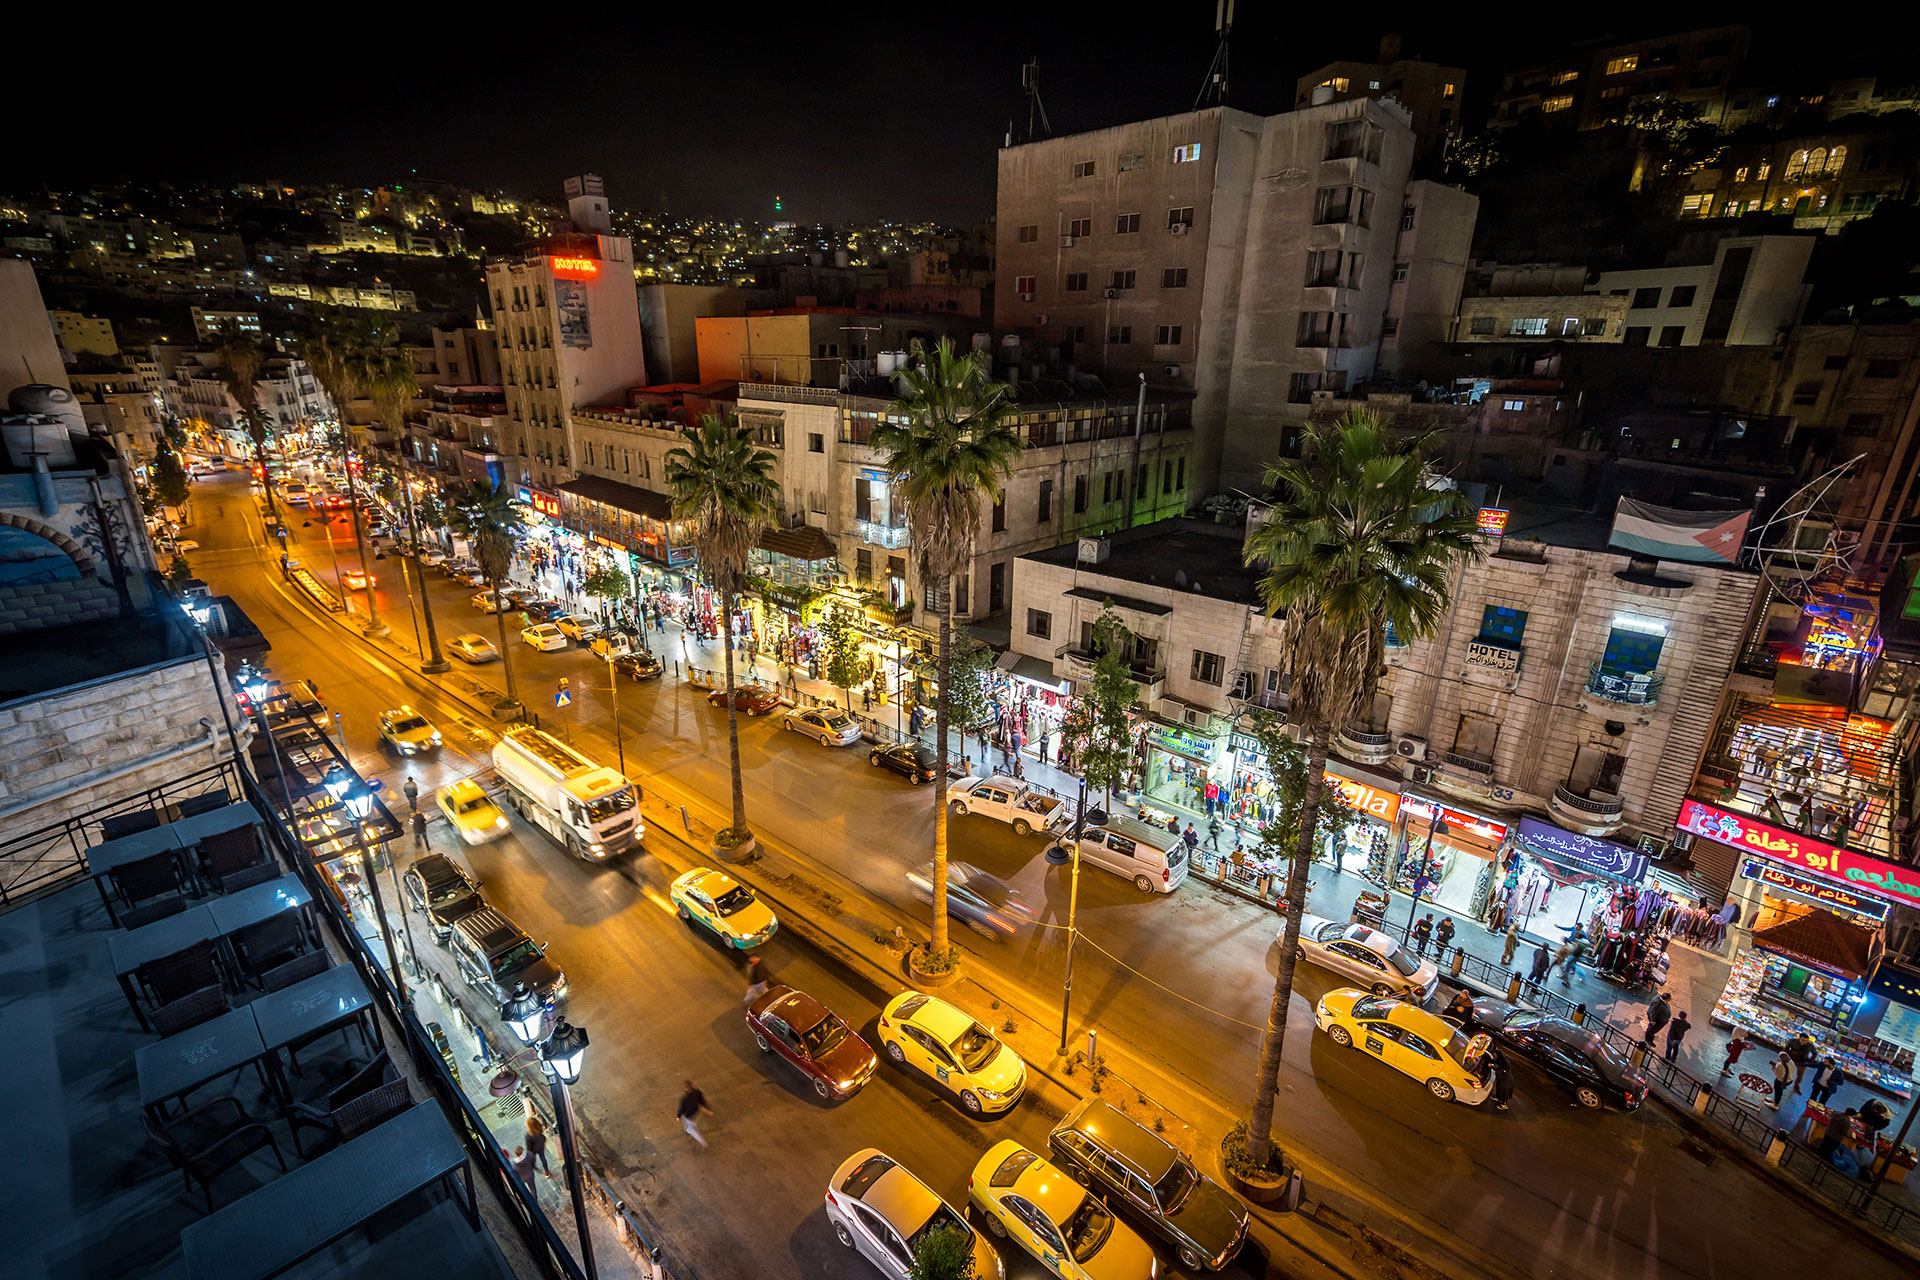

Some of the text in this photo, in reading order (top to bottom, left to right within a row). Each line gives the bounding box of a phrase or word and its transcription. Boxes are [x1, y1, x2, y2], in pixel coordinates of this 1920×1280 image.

[555, 258, 597, 272] HOTEL
[1469, 644, 1516, 661] HOTEL
[1484, 658, 1498, 667] بغداد
[1498, 660, 1515, 671] فندق
[1177, 744, 1211, 760] EXCHANE
[1494, 787, 1514, 801] 33
[1805, 850, 1841, 872] أبو
[1796, 883, 1815, 894] ابو
[1845, 868, 1920, 897] مطعم
[1818, 889, 1857, 906] مطاعم
